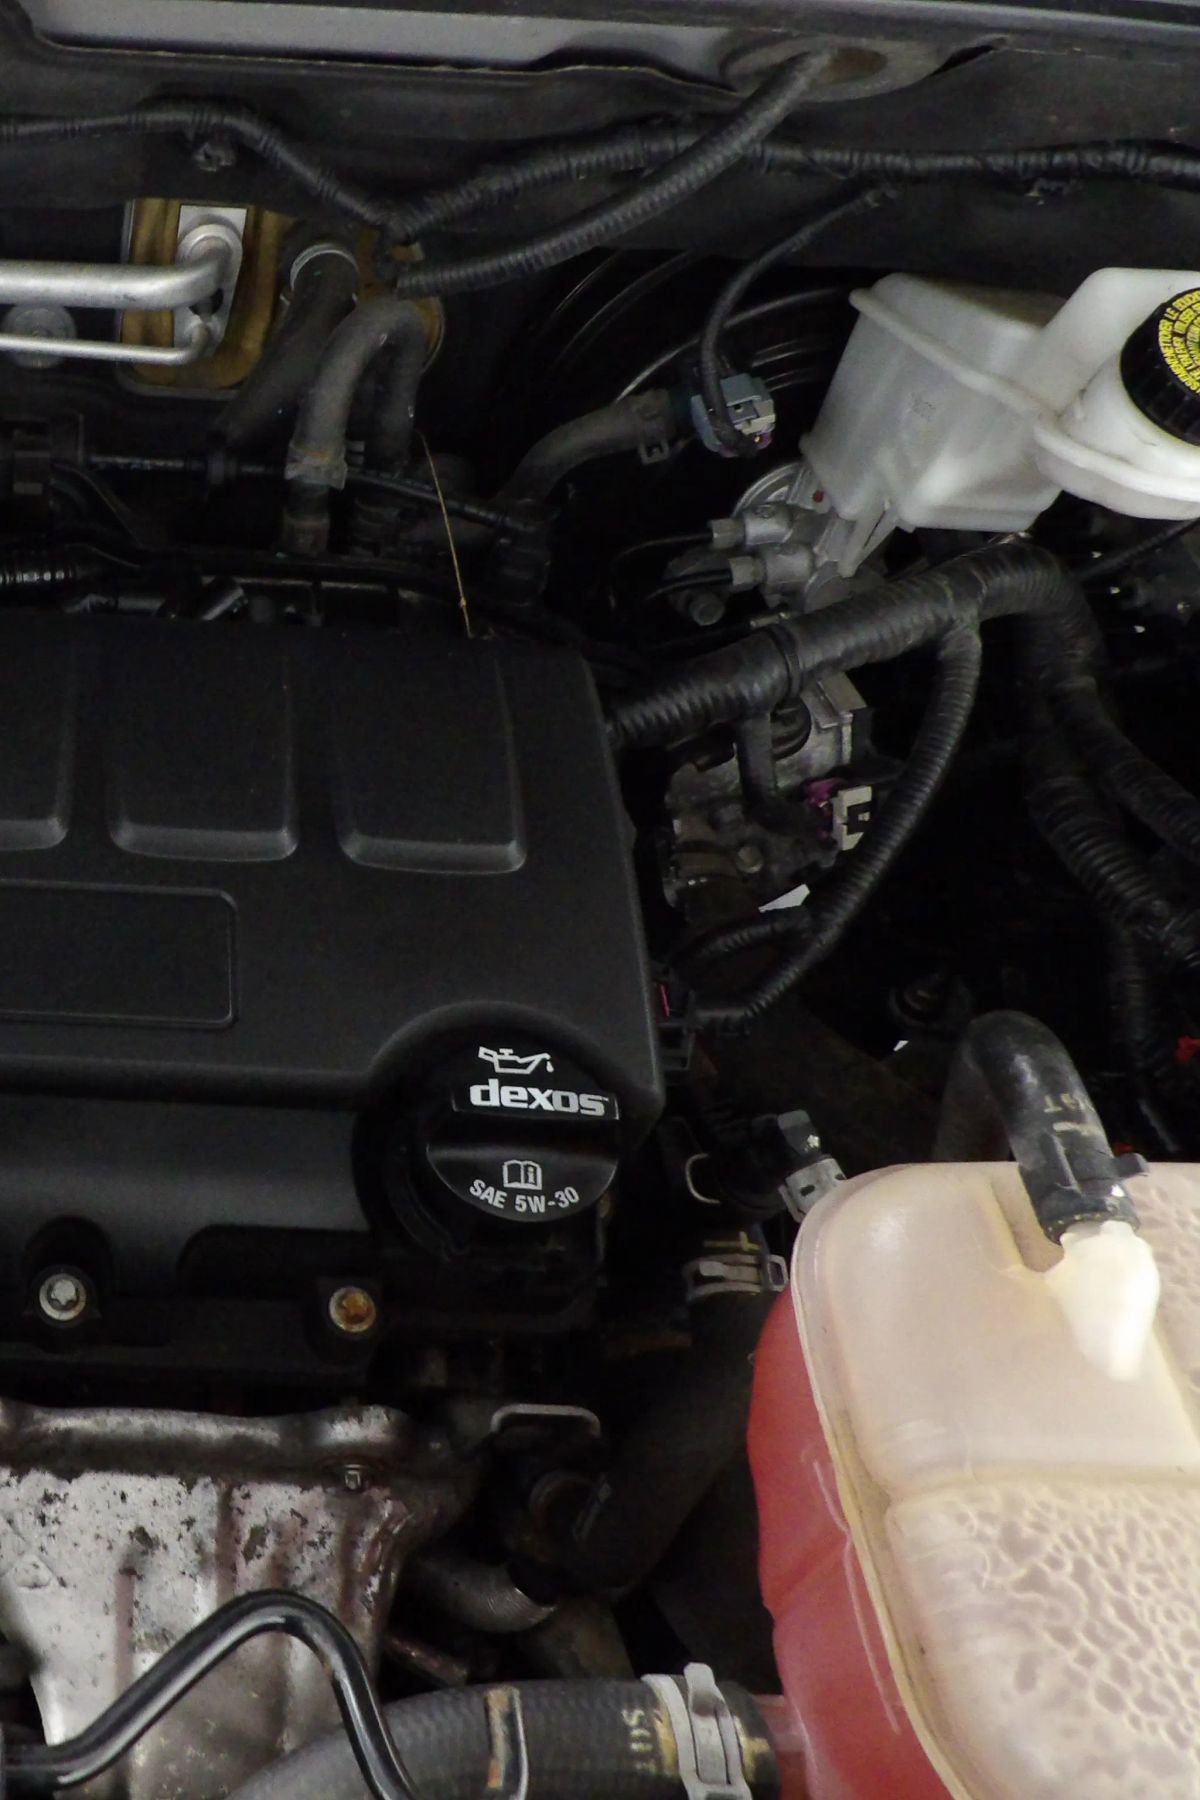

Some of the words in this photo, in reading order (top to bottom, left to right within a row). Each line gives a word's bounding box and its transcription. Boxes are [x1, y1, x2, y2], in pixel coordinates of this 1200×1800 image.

[469, 1079, 608, 1116] dexos
[470, 1179, 507, 1209] SAE
[515, 1187, 579, 1213] 5W-30
